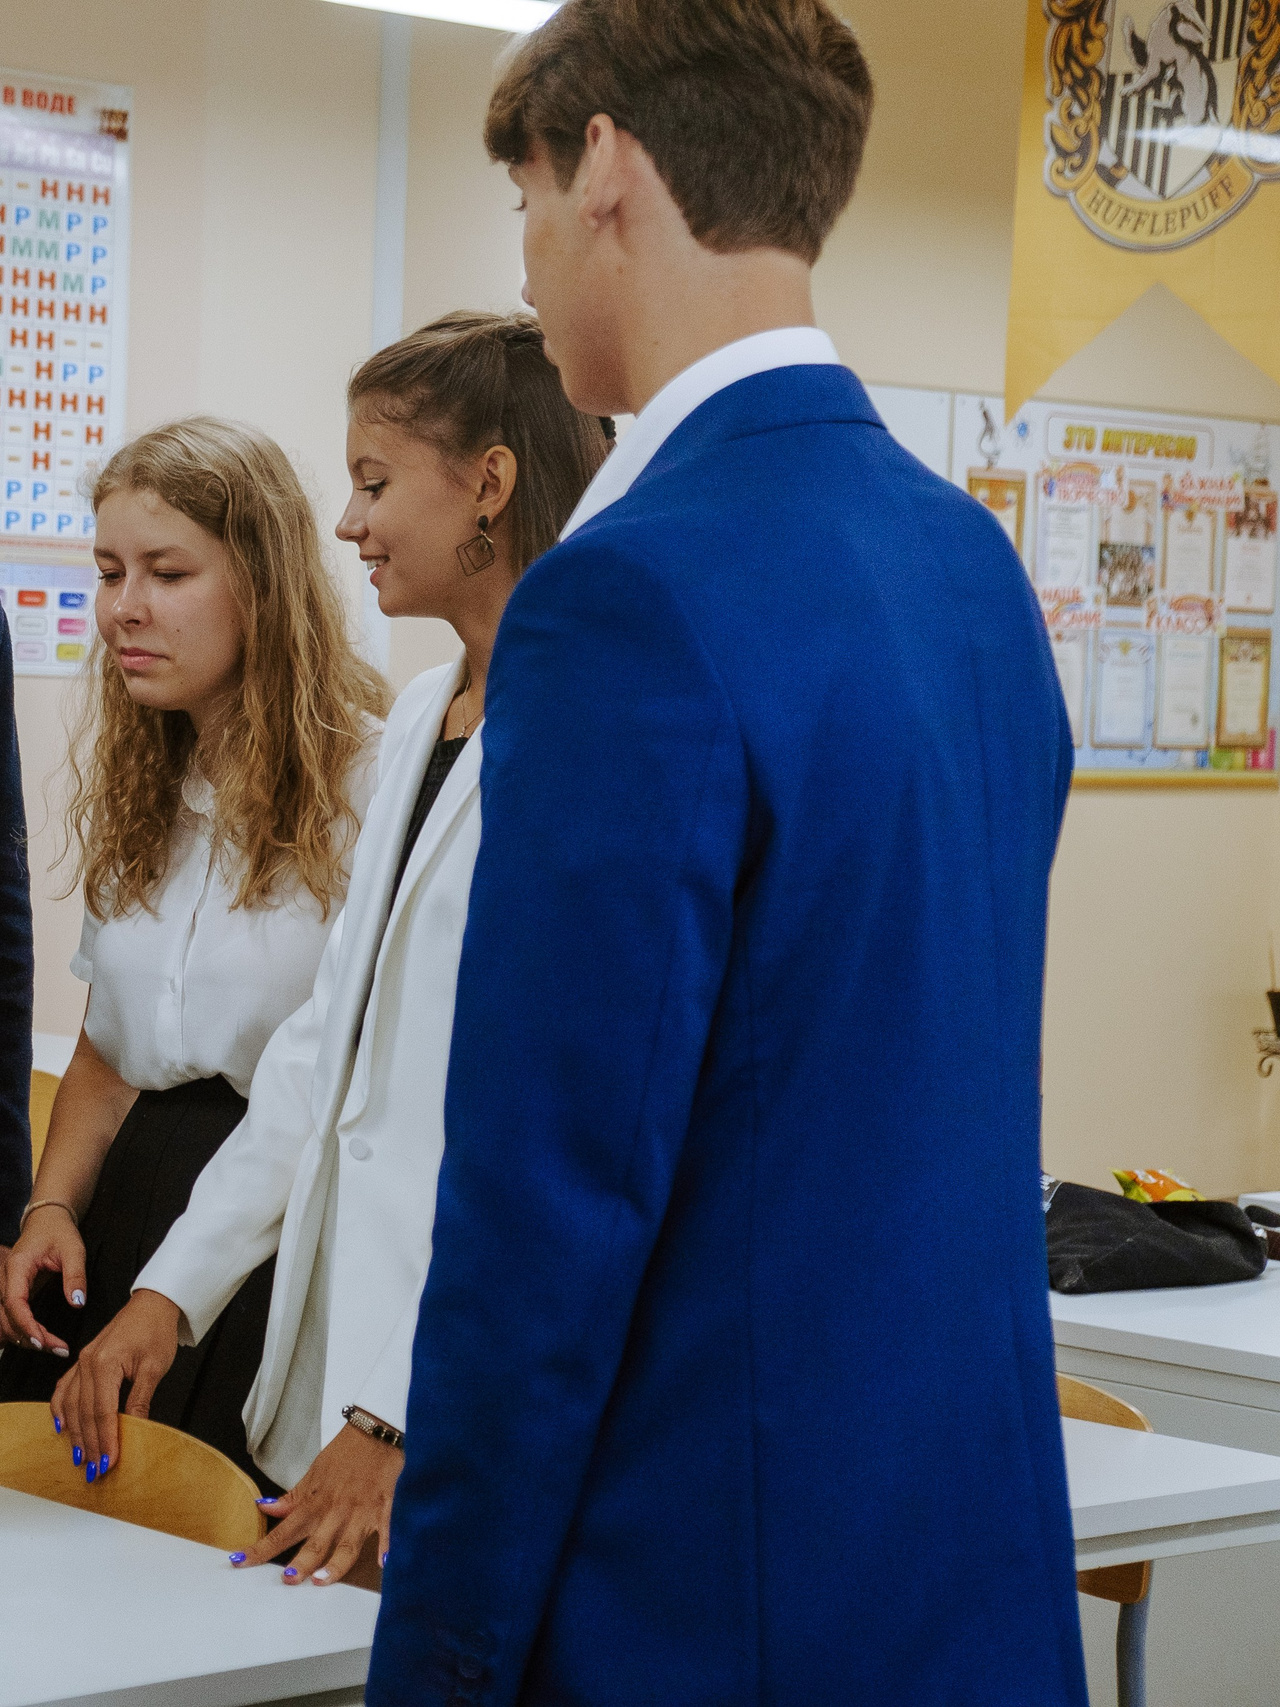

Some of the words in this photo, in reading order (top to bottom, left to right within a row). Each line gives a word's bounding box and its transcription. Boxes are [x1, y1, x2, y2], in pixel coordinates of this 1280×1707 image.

[2, 85, 17, 107] В
[23, 87, 76, 116] ВОДЕ
[1086, 175, 1236, 236] HUFFLEPUFF
